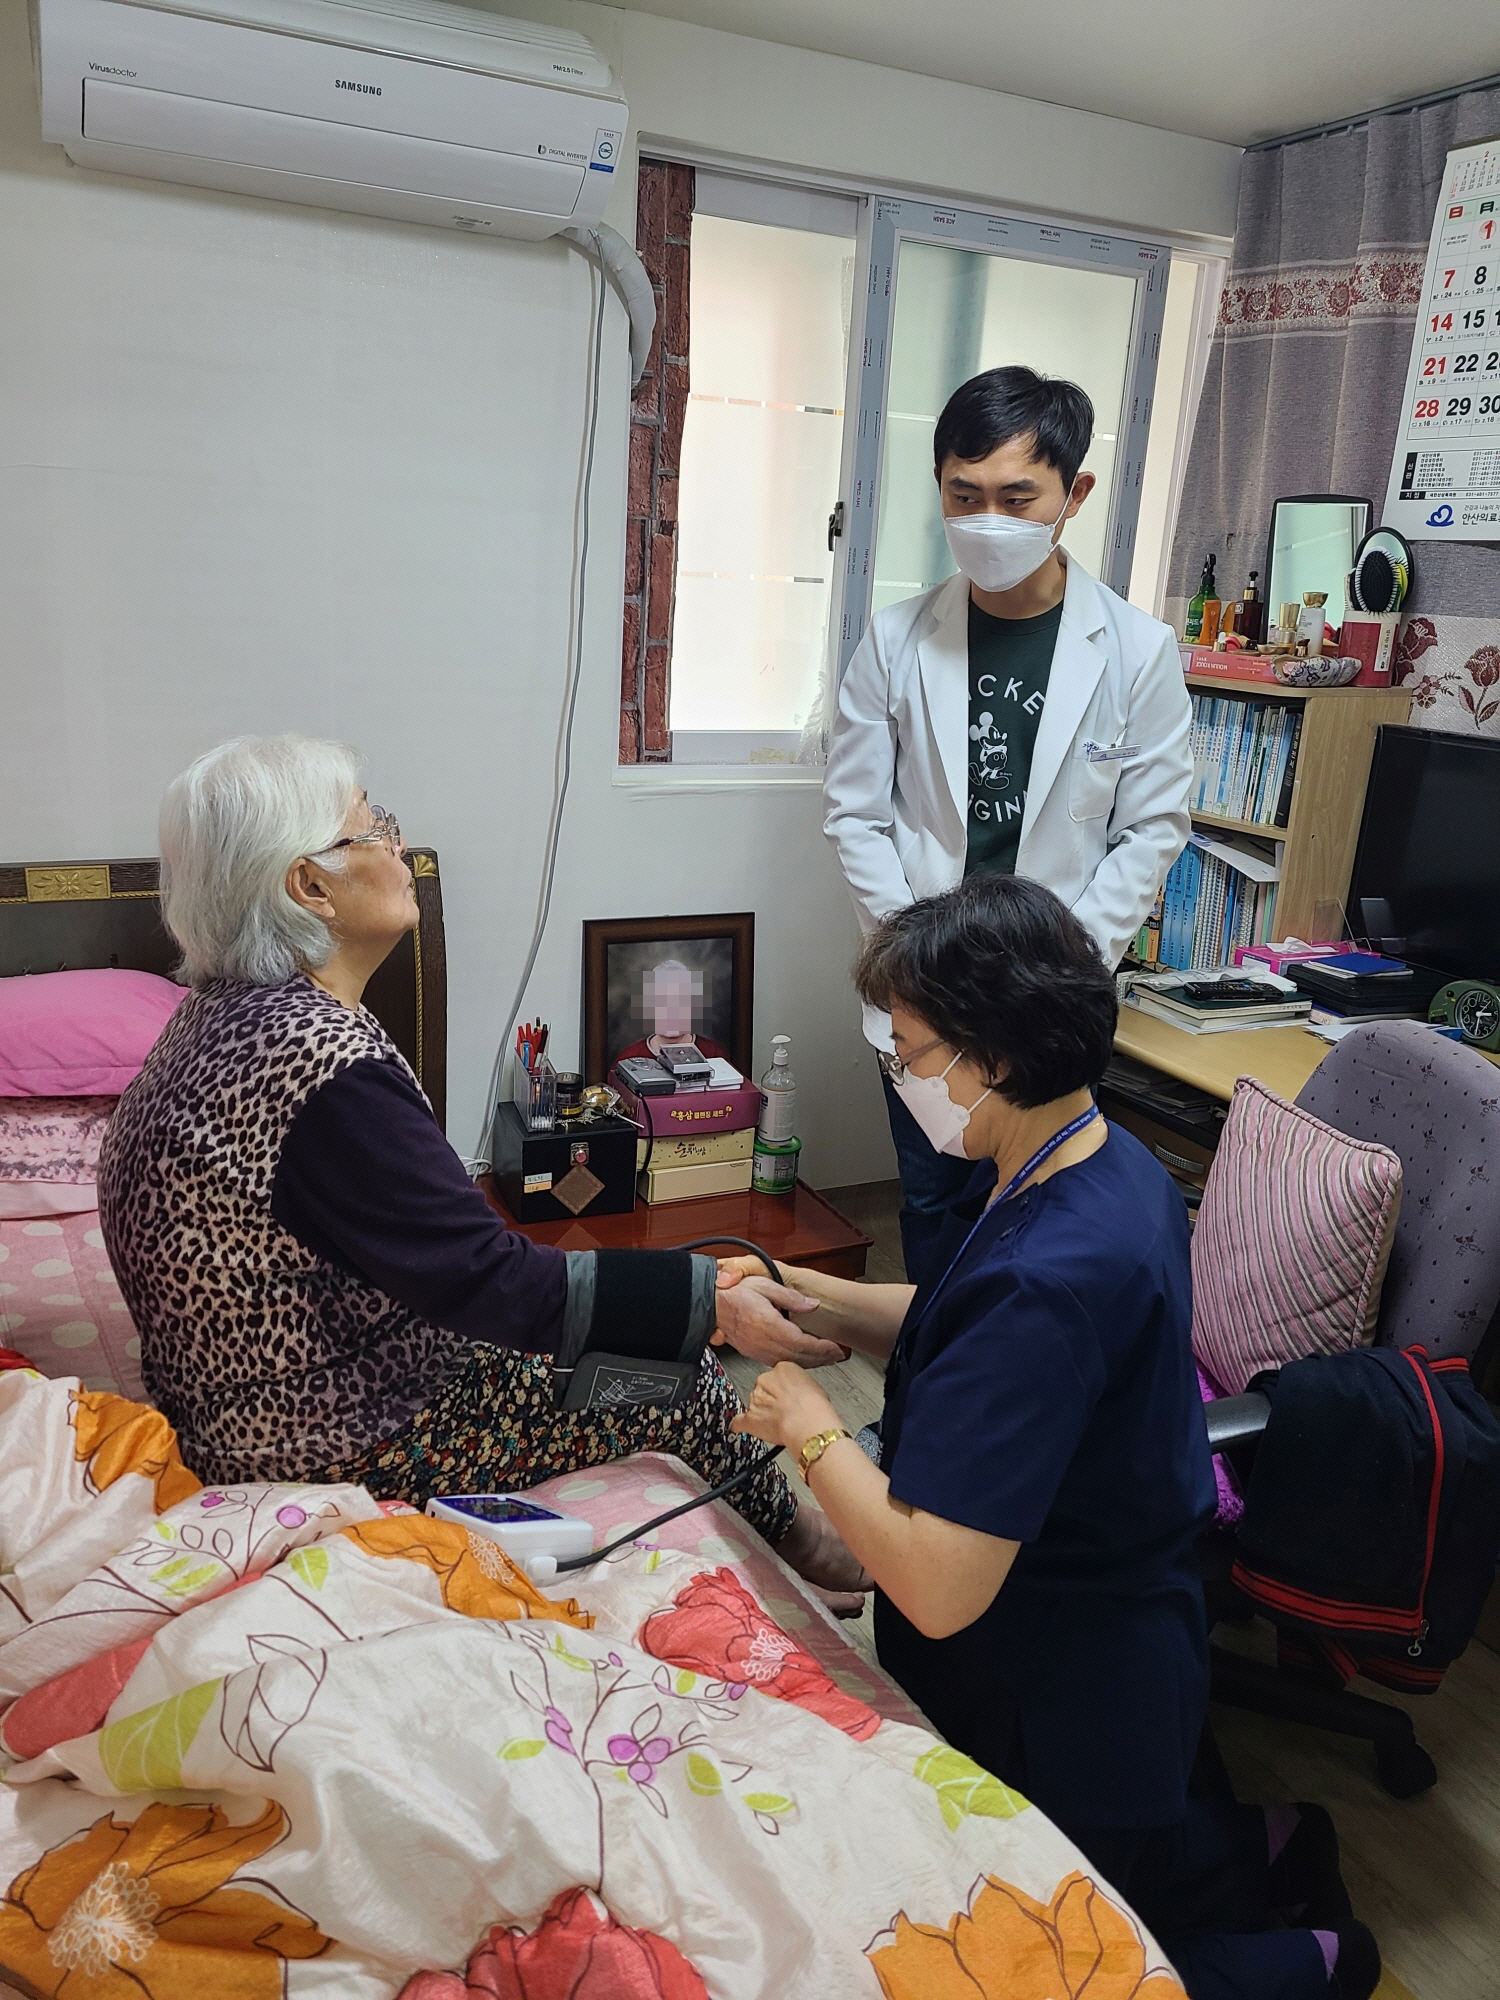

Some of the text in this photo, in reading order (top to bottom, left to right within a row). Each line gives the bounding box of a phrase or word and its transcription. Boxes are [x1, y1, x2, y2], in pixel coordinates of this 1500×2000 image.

[88, 61, 138, 78] Virusdoctor
[335, 79, 382, 96] SAMSUNG
[548, 148, 566, 157] DIGITAL
[566, 151, 588, 161] INVERTER
[1484, 150, 1490, 158] 2
[1448, 200, 1495, 219] 日 月
[1484, 219, 1494, 240] 1
[1444, 265, 1488, 289] 7 8
[1431, 312, 1454, 333] 14
[1463, 308, 1486, 329] 15
[1423, 351, 1500, 376] 21 22 2
[1414, 399, 1440, 419] 28
[1446, 397, 1472, 416] 29
[676, 1109, 693, 1121] 홍삼
